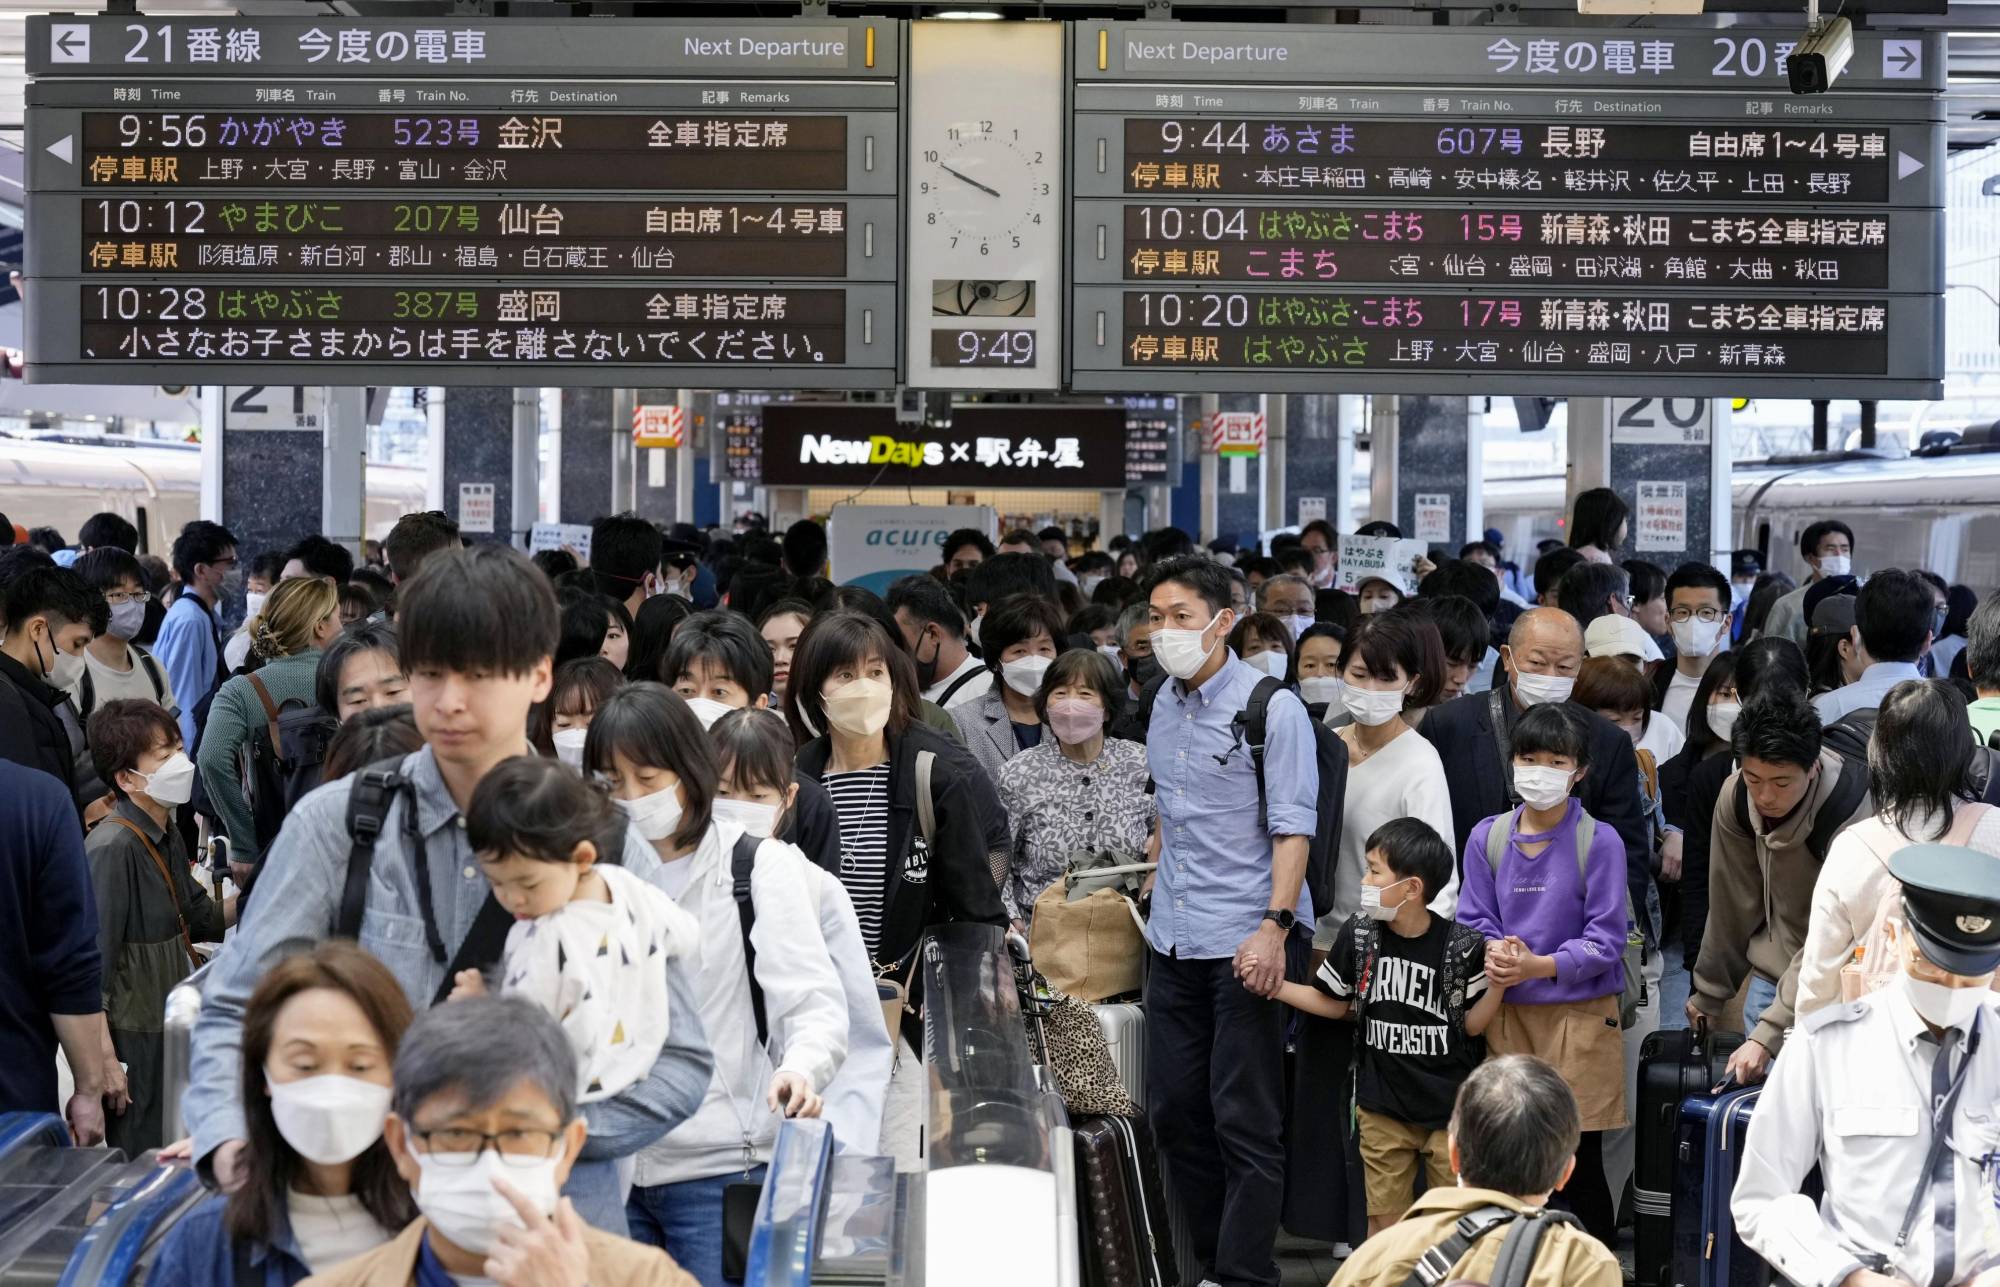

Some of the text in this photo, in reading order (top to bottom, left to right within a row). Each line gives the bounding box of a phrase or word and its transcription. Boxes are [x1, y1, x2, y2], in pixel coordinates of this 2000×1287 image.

[297, 28, 487, 64] 今度の電車
[684, 38, 845, 60] Next Departure
[1128, 41, 1288, 64] Next Departure
[1487, 38, 1675, 75] 今度の電車
[113, 88, 181, 101] 時刻 Time
[255, 88, 336, 102] 列車名 Train
[378, 89, 470, 103] 番号 Train No.
[511, 89, 618, 103] 行先 Destination
[702, 90, 790, 104] 記事 Remarks
[1156, 94, 1224, 108] 時刻 Time
[1298, 96, 1379, 110] 列車名 Train
[1422, 98, 1514, 112] 番号 Train No.
[1555, 99, 1661, 113] 行先 Destination
[1746, 101, 1833, 115] 記事 Remarks
[120, 115, 788, 150] 9:56 かがやき 523号 金沢 全車指定席
[980, 121, 993, 133] 12
[948, 129, 960, 140] 11
[1013, 129, 1018, 141] 1
[1161, 121, 1250, 154] 9:44
[1262, 123, 1357, 154] あさま
[1437, 127, 1523, 155] 607号
[1540, 126, 1606, 159] 長野
[924, 150, 938, 162] 10
[1034, 152, 1043, 163] 2
[90, 156, 179, 183] 停車駅
[1131, 162, 1220, 189] 停車駅
[921, 182, 929, 194] 9
[1041, 184, 1049, 195] 3
[98, 201, 205, 233] 10:12
[219, 205, 344, 232] やまびこ
[394, 205, 480, 232] 207号
[497, 203, 564, 236] 仙台
[927, 213, 936, 225] 8
[1032, 213, 1041, 225] 4
[1140, 207, 1248, 240] 10:04
[1459, 214, 1523, 242] 15号
[1688, 217, 1886, 246] こまち全車指定席
[950, 237, 958, 249] 7
[980, 243, 989, 255] 6
[1012, 236, 1020, 248] 5
[89, 242, 178, 268] 停車駅
[1131, 248, 1220, 275] 停車駅
[1246, 249, 1338, 279] こまち
[97, 287, 787, 322] 10:28 はやぶさ 387号 盛岡 全車指定席
[1139, 293, 1248, 327] 10:20
[1459, 300, 1523, 328] 17号
[1688, 304, 1886, 332] こまち全車指定席
[958, 331, 1033, 364] 9:49
[1130, 335, 1220, 361] 停車駅
[1244, 334, 1368, 365] はやぶさ
[800, 434, 944, 467] NewDays
[975, 437, 1084, 468] 駅弁屋
[866, 529, 949, 546] acure
[1345, 546, 1384, 559] はやぶさ
